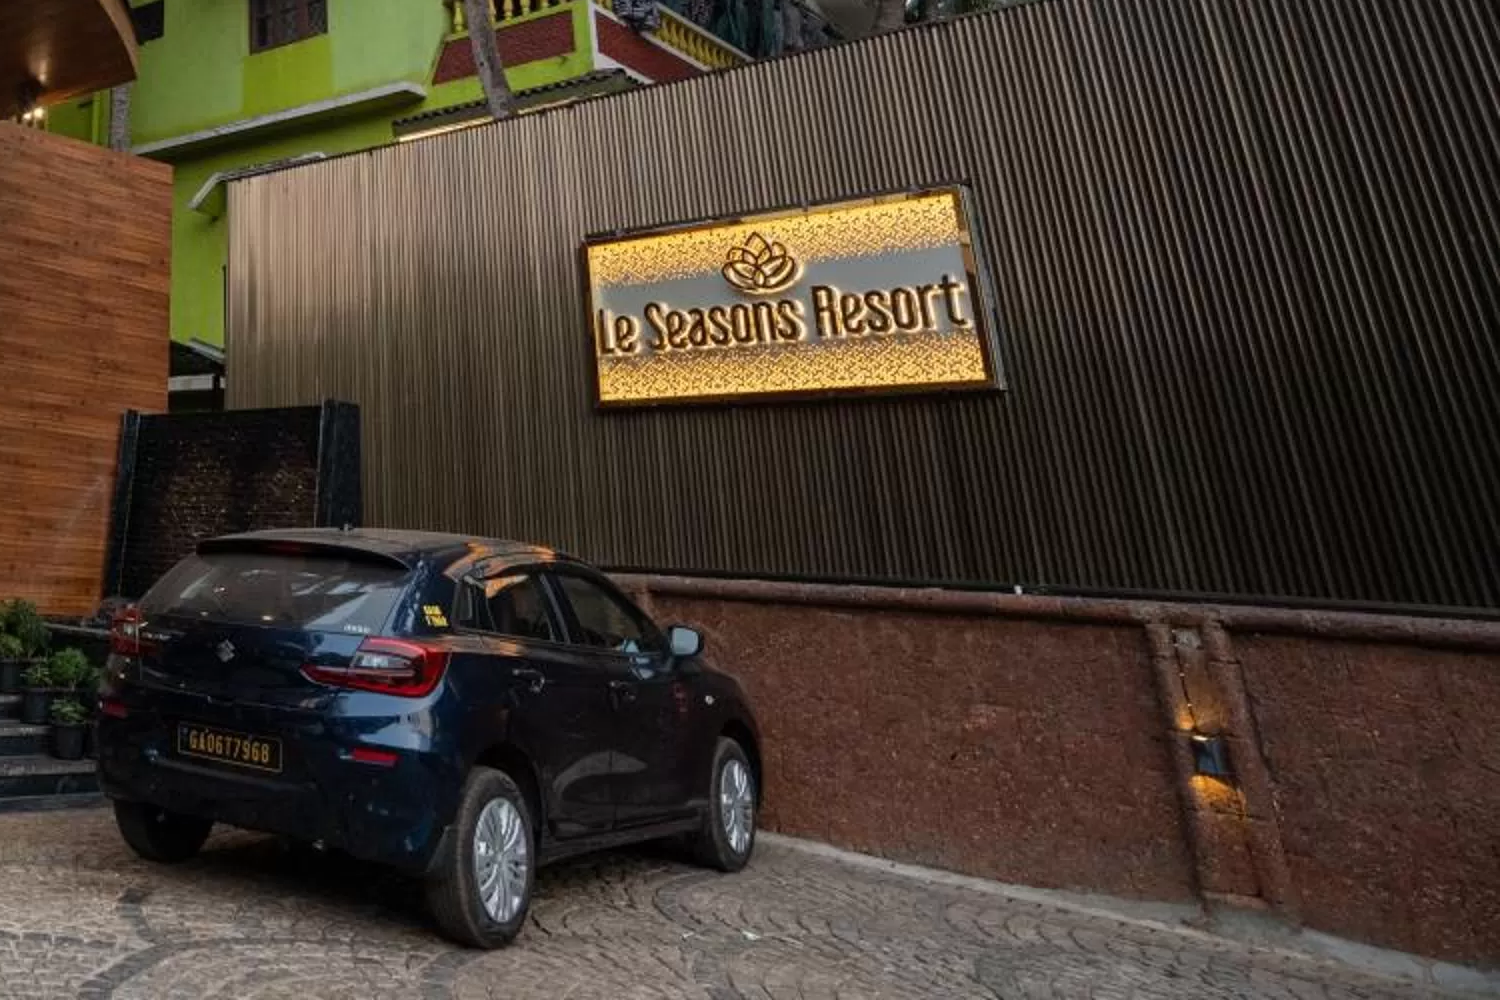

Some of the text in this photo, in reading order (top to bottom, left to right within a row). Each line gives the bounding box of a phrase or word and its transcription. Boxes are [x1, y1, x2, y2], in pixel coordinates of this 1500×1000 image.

[598, 275, 967, 355] Le Seasons Resort
